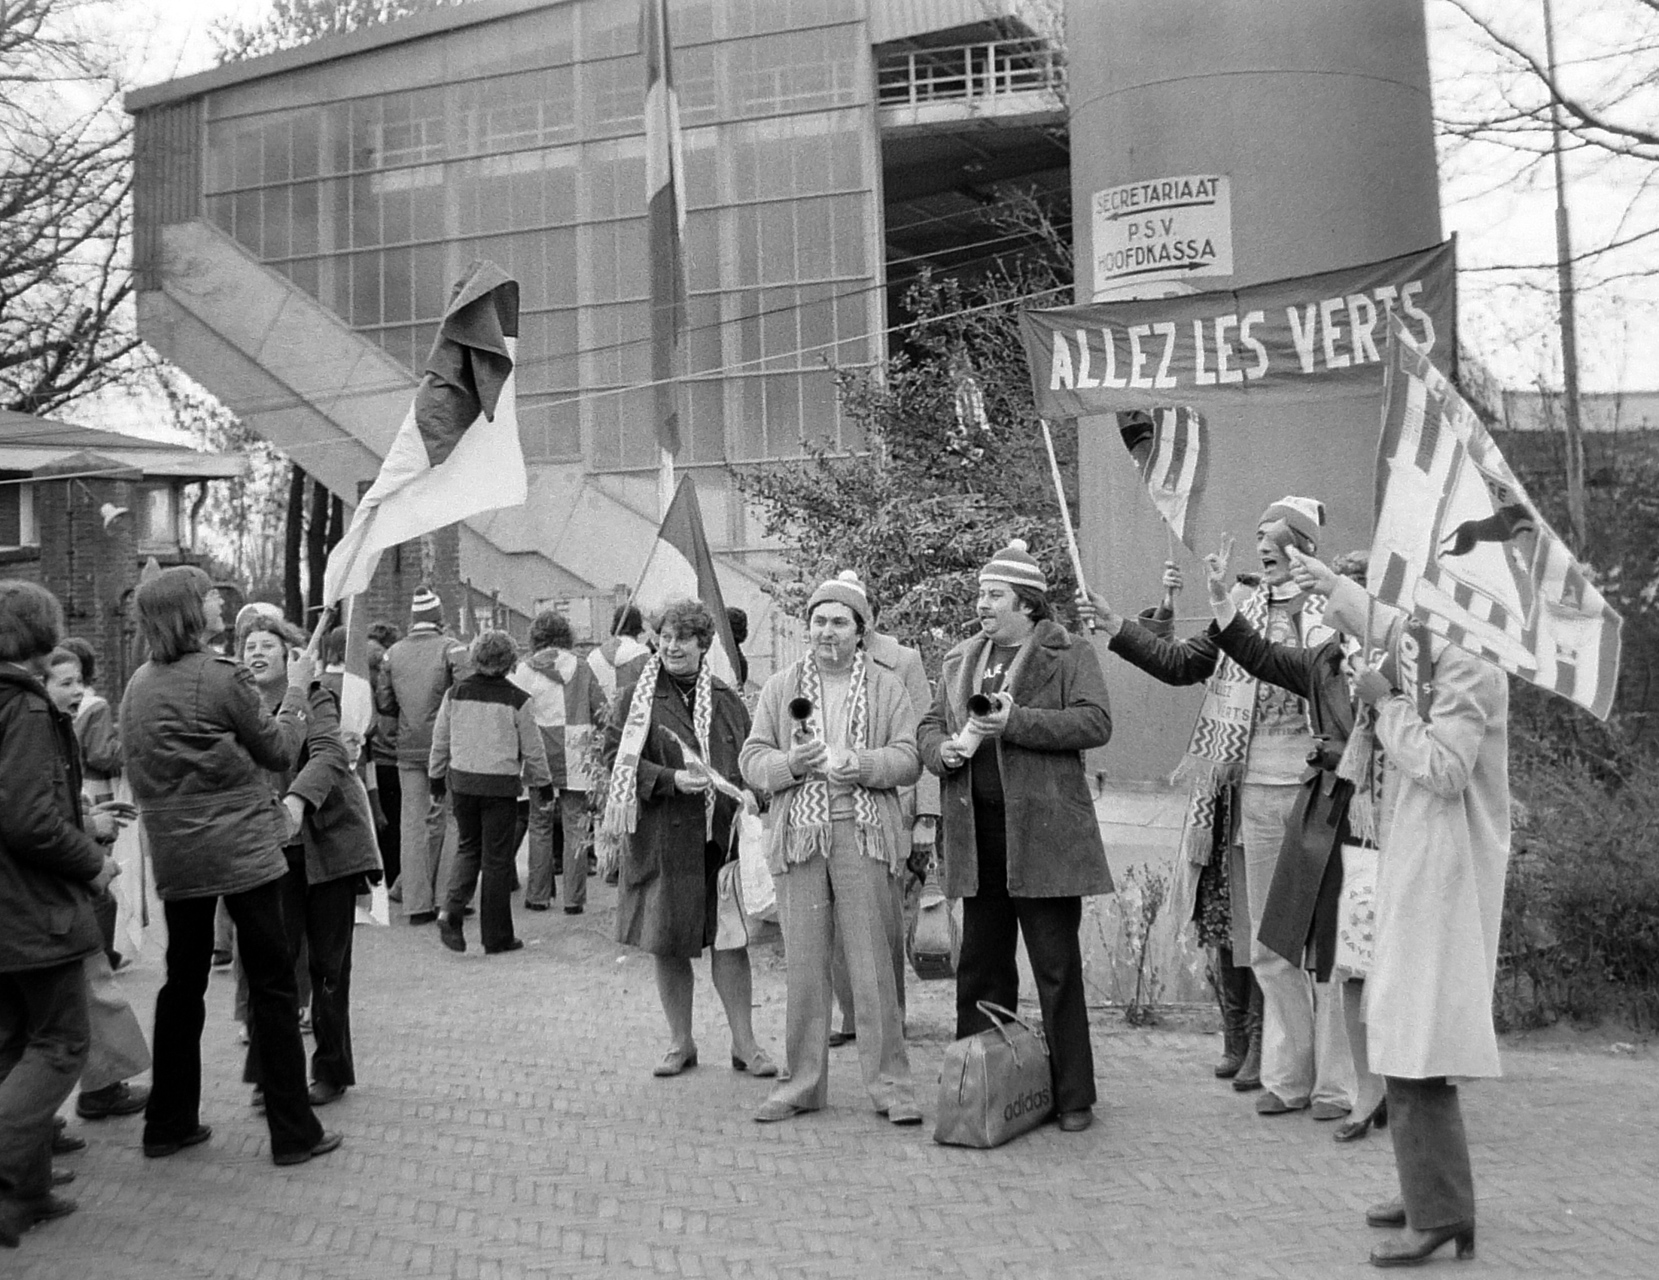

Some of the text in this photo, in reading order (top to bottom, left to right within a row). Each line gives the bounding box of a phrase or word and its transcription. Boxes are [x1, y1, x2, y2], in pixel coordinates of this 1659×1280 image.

[1097, 178, 1219, 213] SECRETARIAAT
[1050, 280, 1436, 390] ALLEZ LES VERTS
[1004, 1088, 1050, 1121] adidas
